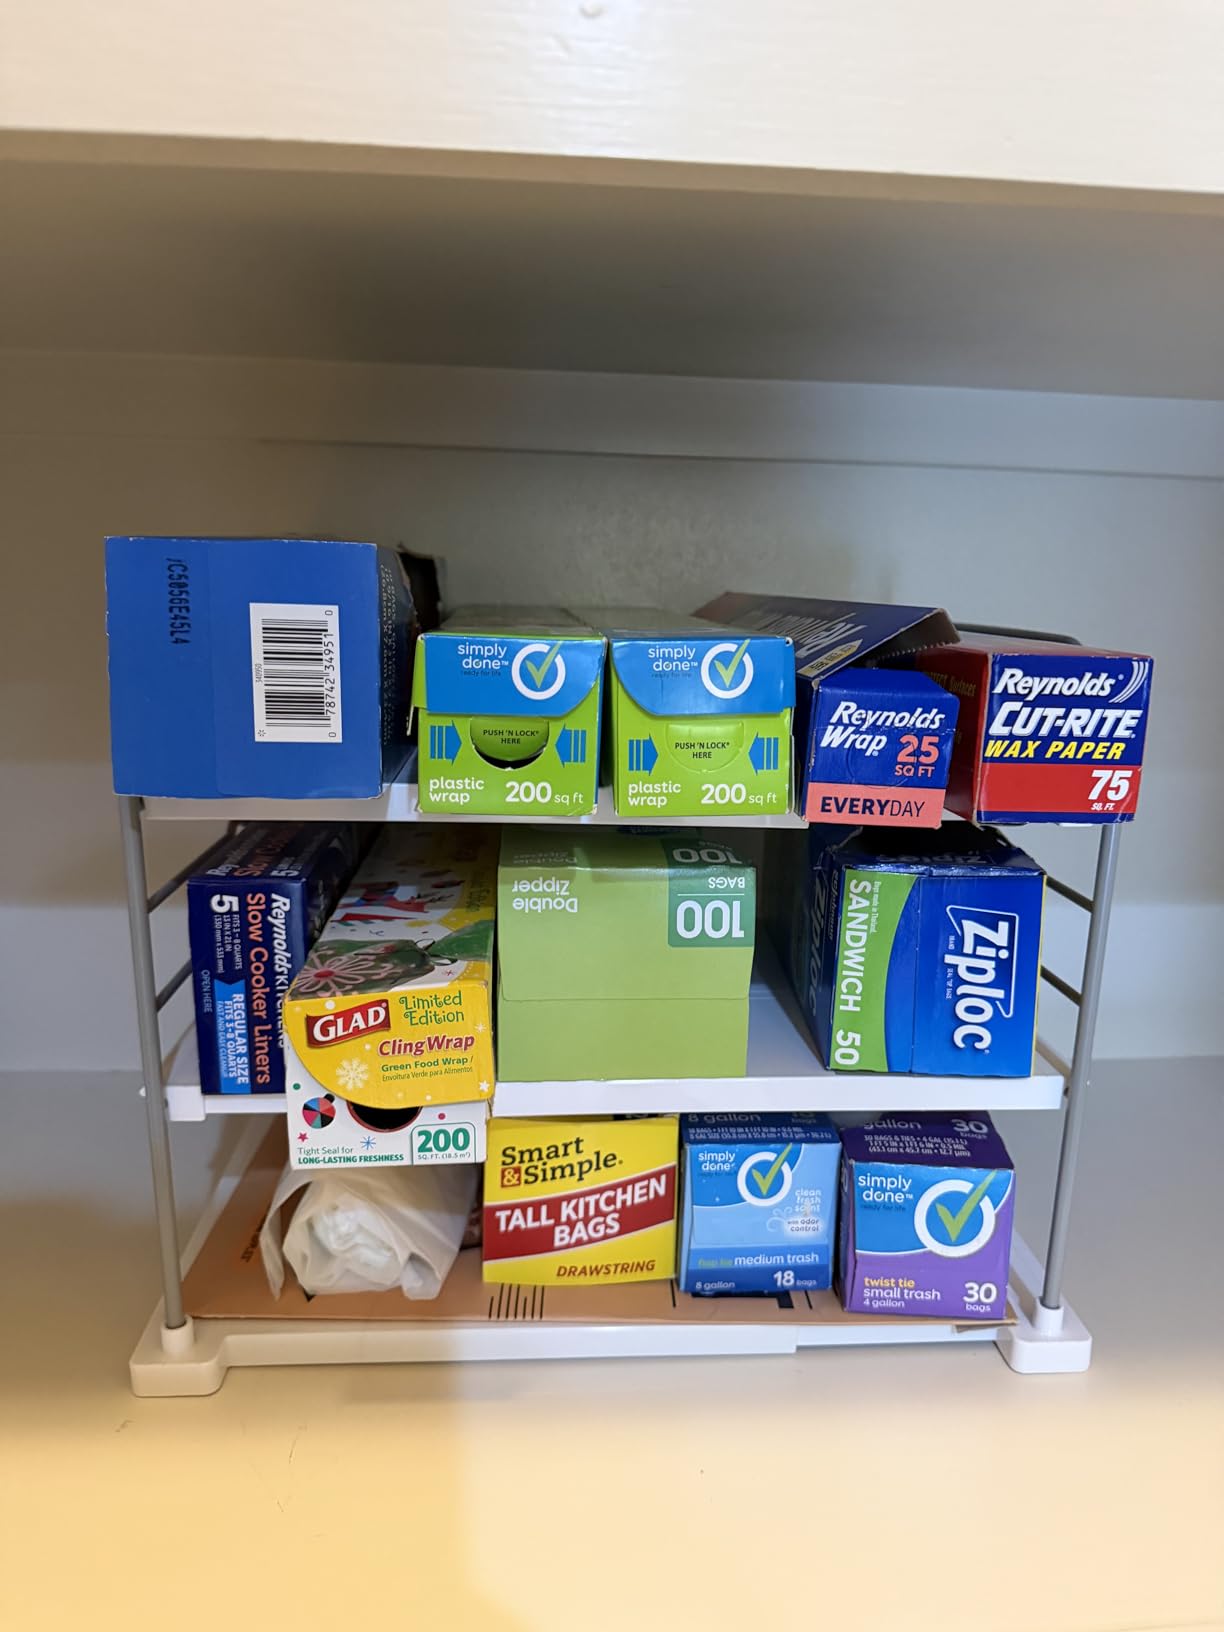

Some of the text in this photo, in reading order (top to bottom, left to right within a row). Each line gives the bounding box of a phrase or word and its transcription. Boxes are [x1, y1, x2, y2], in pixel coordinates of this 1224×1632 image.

[324, 633, 335, 672] 34951
[457, 642, 507, 658] simply
[648, 644, 696, 660] simply
[992, 668, 1116, 701] Reynolds
[325, 678, 336, 716] 78742
[829, 700, 945, 730] Reynolds
[988, 701, 1143, 739] CUT-RITE
[674, 741, 695, 749] PUSH
[820, 725, 888, 756] Wrap
[896, 735, 940, 764] 25
[984, 740, 1126, 760] WAX PAPER
[692, 751, 712, 759] HERE
[895, 764, 936, 778] SQ FT
[429, 776, 485, 795] plastic
[505, 781, 584, 805] 200 sq ft
[628, 780, 681, 798] plastic
[1088, 769, 1133, 801] 75
[429, 790, 470, 804] wrap
[628, 794, 667, 808] wrap
[700, 783, 777, 807] 200 sq ft
[821, 796, 925, 818] EVERYDAY
[512, 877, 570, 896] Zipper
[708, 876, 745, 888] BAGS
[210, 894, 240, 913] 5
[512, 897, 578, 913] Double
[232, 914, 240, 928] FITS
[246, 893, 266, 942] Slow
[676, 900, 745, 938] 100
[267, 893, 291, 974] Reynolds
[234, 944, 242, 970] QUARTS
[834, 880, 871, 1066] SANDWICH 50
[201, 969, 213, 1013] OPEN HERE
[250, 947, 270, 1019] Cooker
[945, 921, 1009, 1050] Ziploc
[225, 1000, 234, 1020] FITS
[398, 990, 462, 1012] Limited
[313, 1006, 386, 1042] GLAD
[404, 1010, 464, 1027] Edition
[232, 994, 249, 1084] REGULAR SIZE
[227, 1042, 237, 1078] QUARTS
[254, 1024, 272, 1084] Liners
[382, 1062, 412, 1072] Green
[414, 1058, 439, 1068] Food
[442, 1056, 468, 1066] Wrap
[382, 1066, 473, 1082] Envoltura Verde para Alimentos
[703, 1114, 761, 1124] gallon
[952, 1119, 988, 1133] 30
[418, 1128, 470, 1154] 200
[297, 1145, 353, 1157] Tight Seal for
[298, 1153, 404, 1164] LONG-LASTING FRESHNESS
[501, 1136, 584, 1166] Smart
[698, 1151, 736, 1162] simply
[503, 1151, 618, 1186] & Simple
[858, 1174, 912, 1190] simply
[795, 1188, 821, 1197] clean
[496, 1174, 666, 1232] TALL KITCHEN
[554, 1213, 620, 1248] BAGS
[556, 1260, 656, 1278] DRAWSTRING
[734, 1255, 784, 1266] medium
[787, 1253, 819, 1264] trash
[696, 1280, 736, 1290] 8 gallon
[774, 1270, 794, 1288] 18
[864, 1276, 915, 1288] twist tie
[863, 1288, 941, 1300] small trash
[963, 1283, 997, 1303] 30
[870, 1299, 906, 1309] gallon
[966, 1303, 992, 1312] bags
